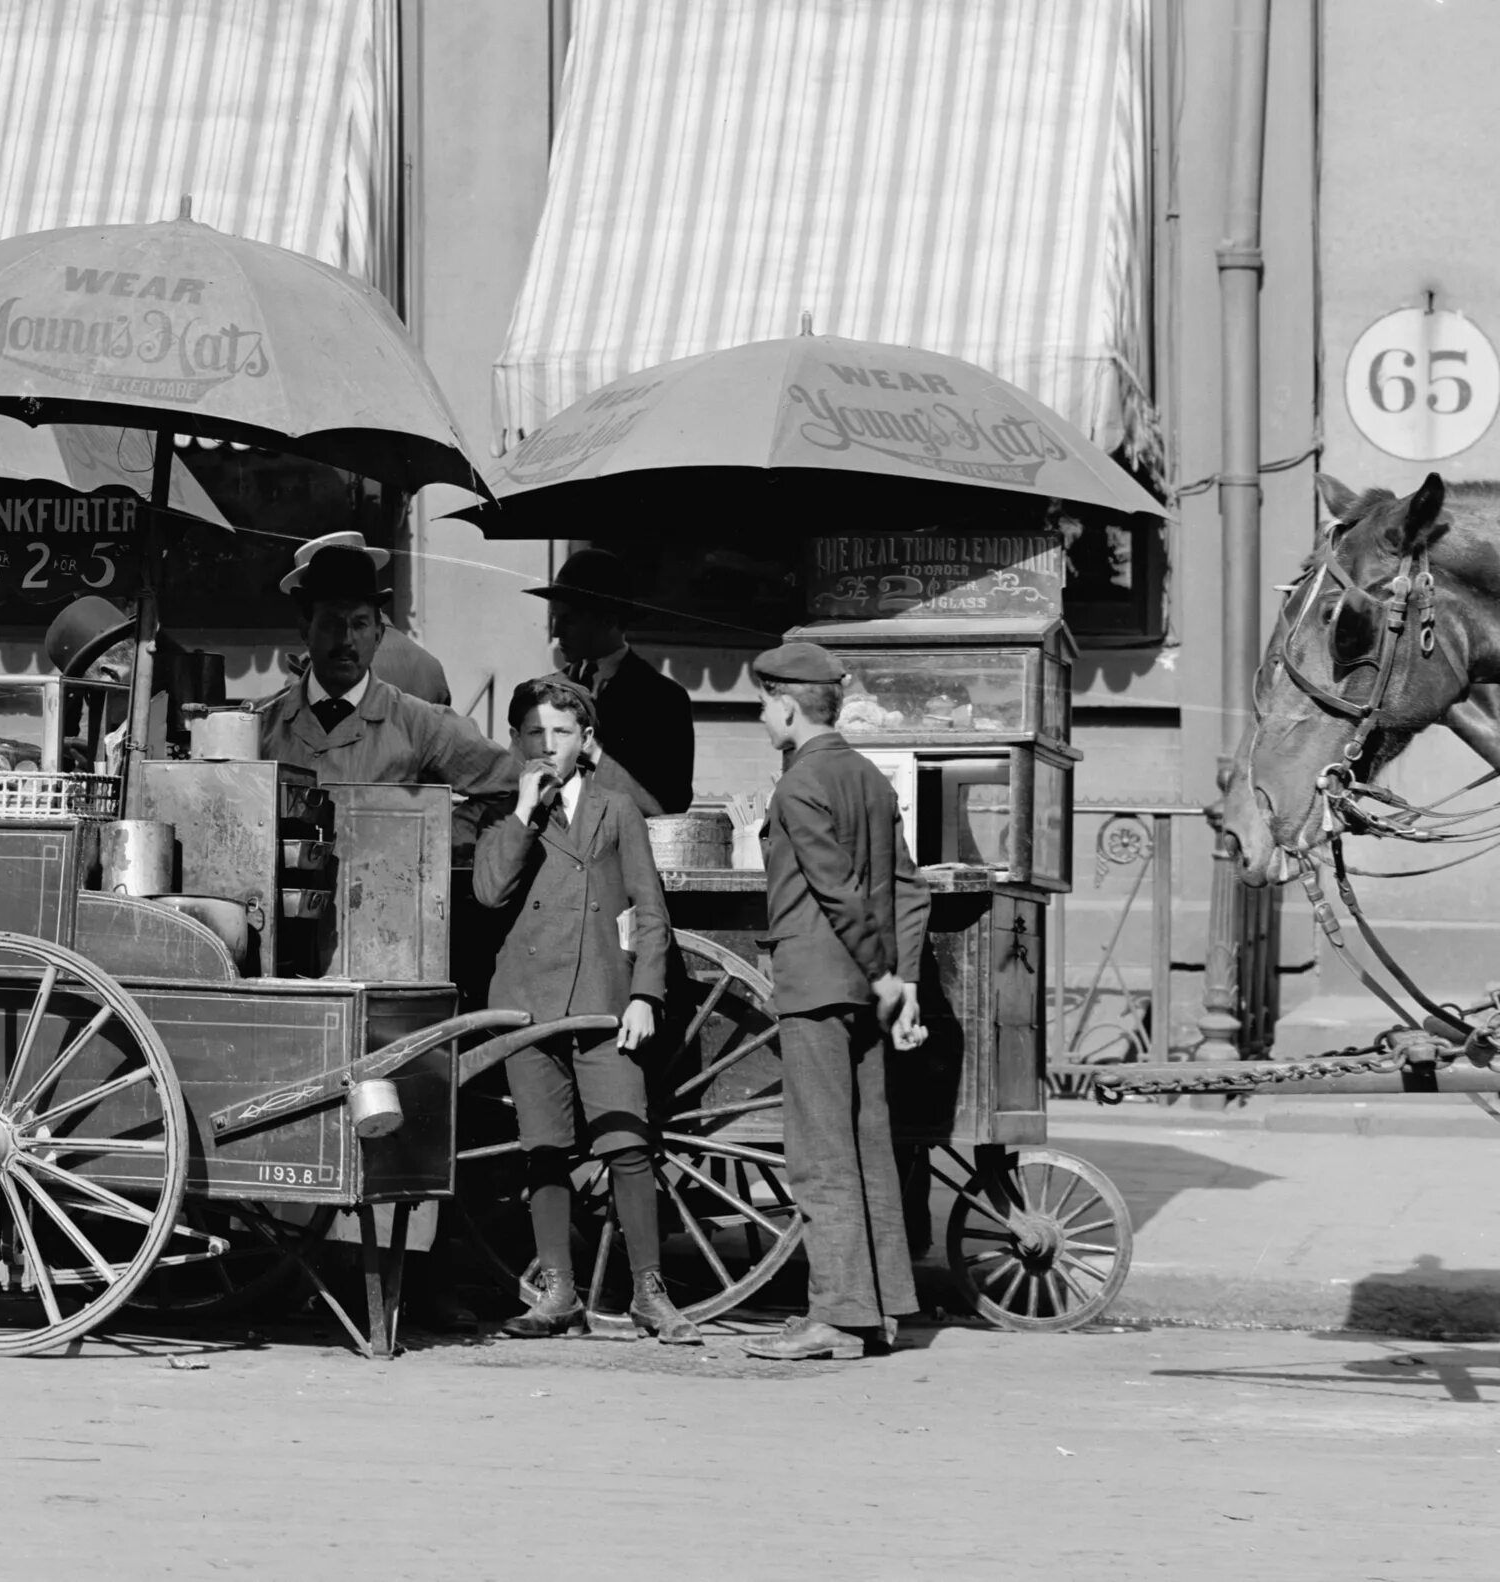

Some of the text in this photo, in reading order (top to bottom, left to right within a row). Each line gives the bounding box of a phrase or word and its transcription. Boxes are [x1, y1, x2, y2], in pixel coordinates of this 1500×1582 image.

[65, 266, 206, 304] WEAR
[137, 310, 270, 378] Hats
[826, 363, 958, 396] WEAR
[1367, 348, 1473, 415] 65
[933, 403, 1067, 462] Hats
[21, 542, 50, 589] 2
[80, 541, 116, 588] 5
[814, 536, 1061, 578] THE REAL THING LEMONADE
[902, 564, 970, 576] TO ORDER
[937, 597, 987, 610] GLASS
